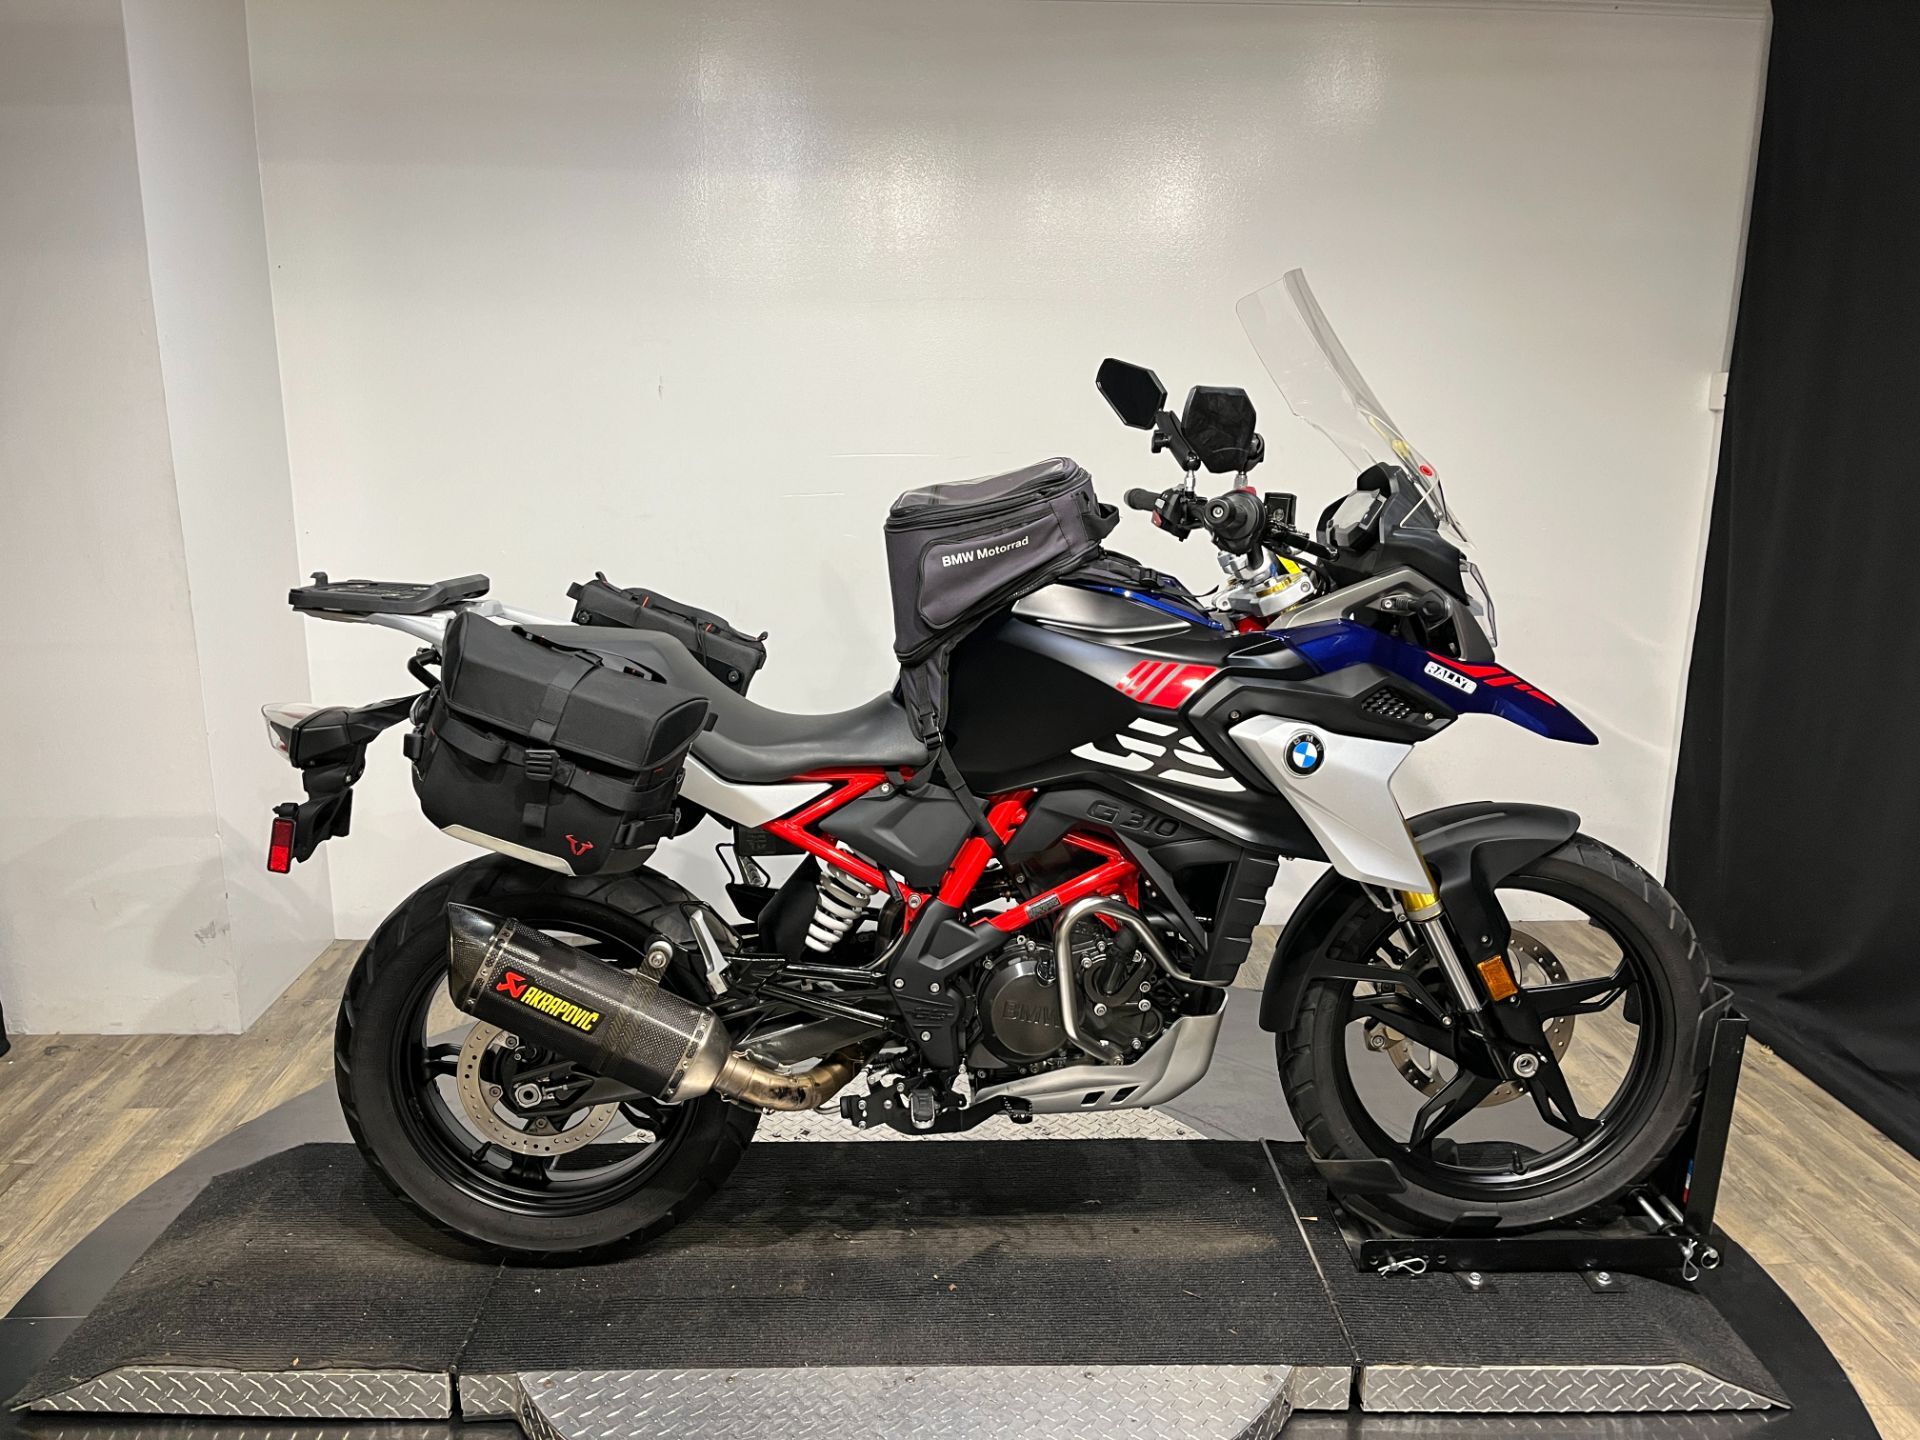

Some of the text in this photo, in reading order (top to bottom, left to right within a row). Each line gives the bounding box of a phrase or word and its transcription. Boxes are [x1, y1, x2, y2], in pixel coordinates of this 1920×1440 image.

[941, 535, 1029, 568] BMW Motorrad
[1086, 800, 1182, 838] G 310
[1002, 1000, 1061, 1029] BMW
